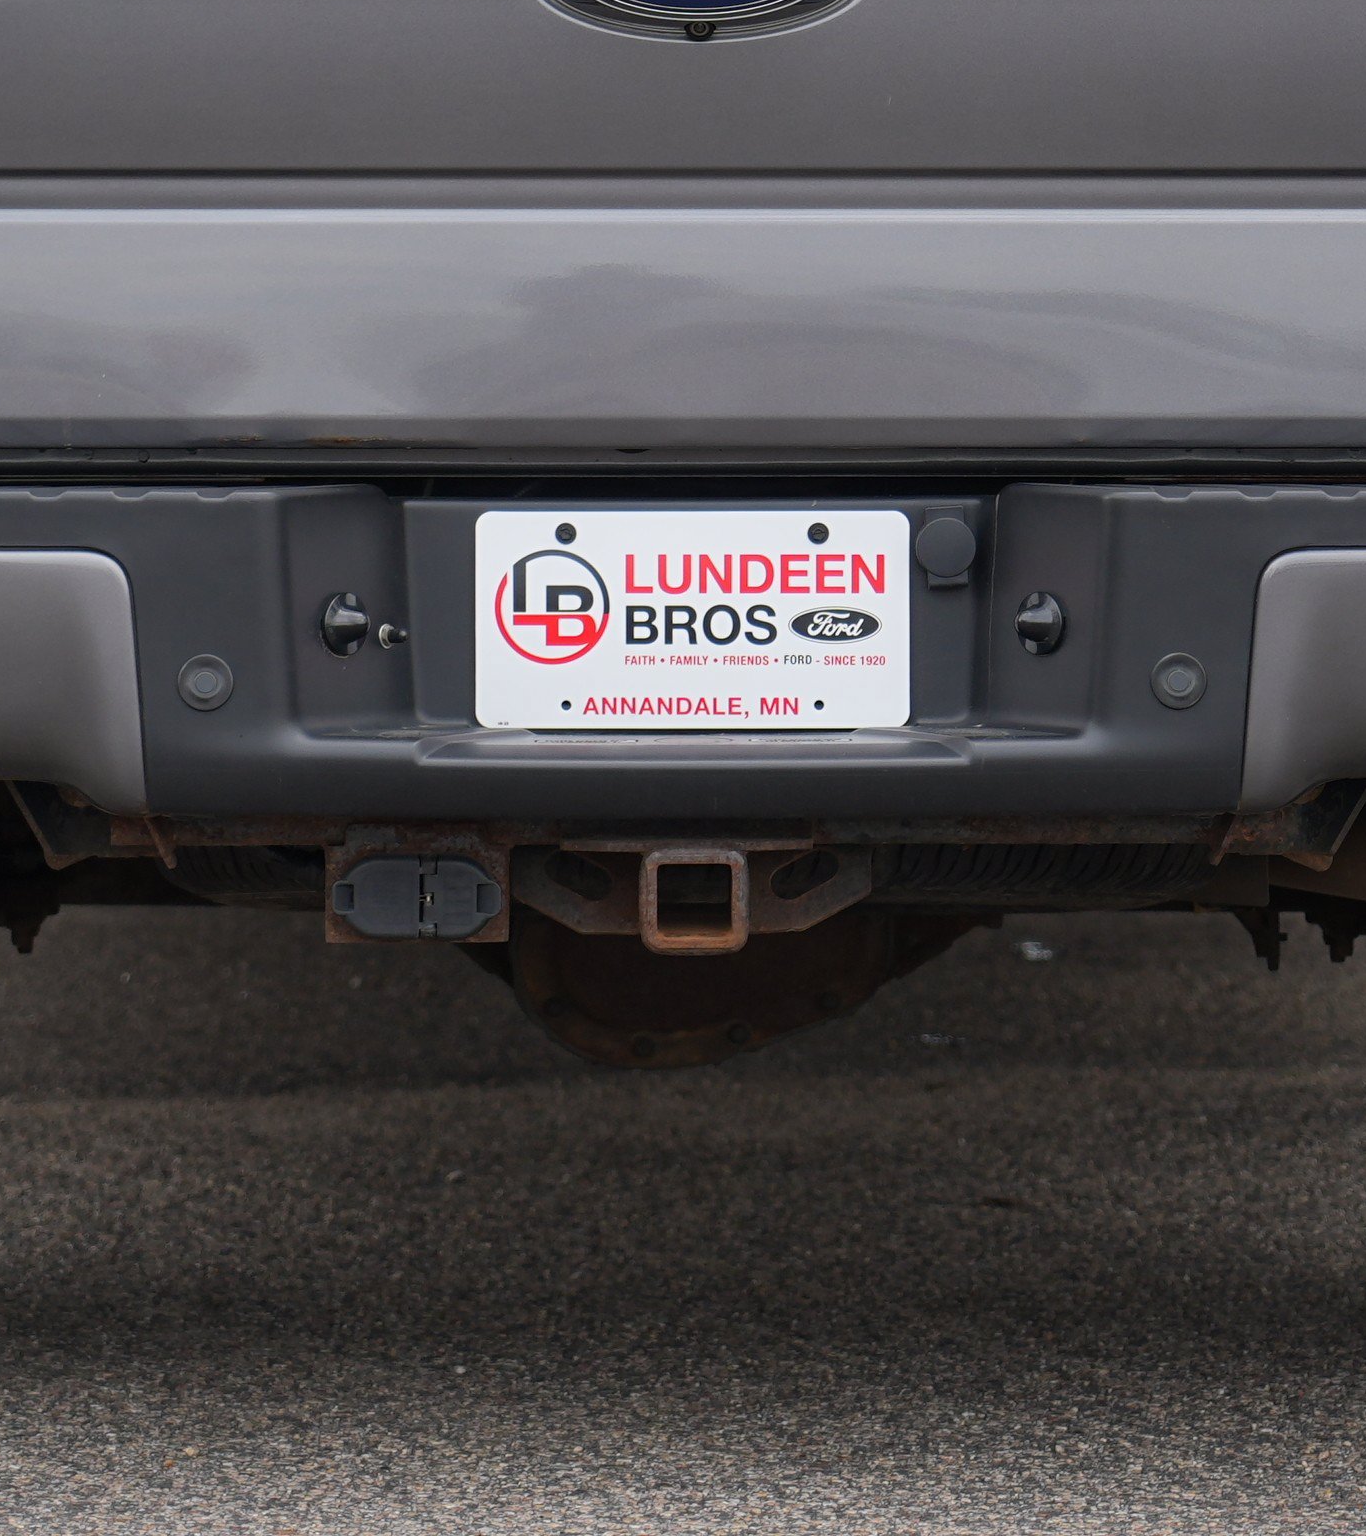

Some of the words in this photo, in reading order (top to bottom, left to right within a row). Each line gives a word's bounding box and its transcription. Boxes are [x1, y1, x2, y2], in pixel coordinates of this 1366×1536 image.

[625, 554, 886, 594] LUNDEEN
[625, 604, 777, 645] BROS
[807, 612, 864, 637] Ford
[625, 655, 656, 666] FAITH
[669, 655, 709, 666] FAMILY
[723, 655, 770, 666] FRIENDS
[783, 654, 813, 665] FORD
[823, 655, 858, 666] SINCE
[860, 655, 886, 666] 1920
[583, 697, 749, 719] ANNANDALE,
[760, 697, 799, 715] MN
